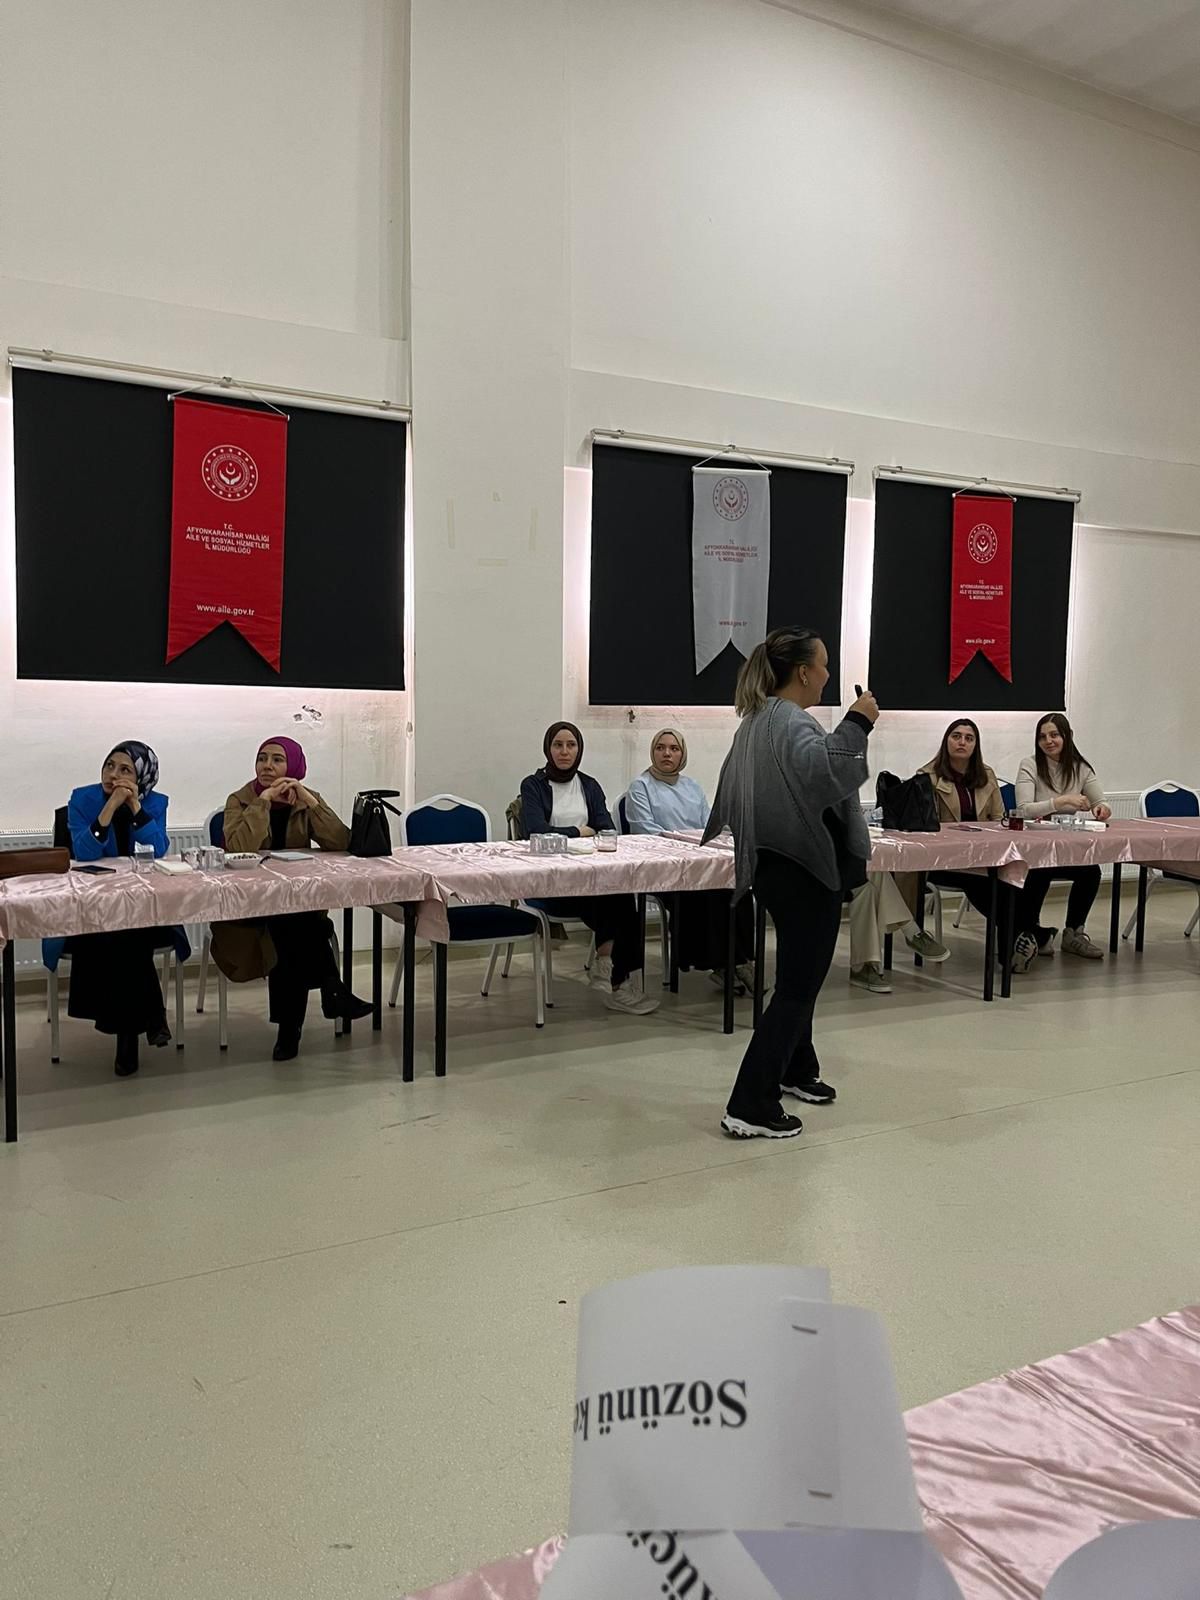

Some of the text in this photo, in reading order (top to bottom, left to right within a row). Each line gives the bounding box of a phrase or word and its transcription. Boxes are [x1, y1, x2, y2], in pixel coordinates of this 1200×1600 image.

[211, 536, 235, 546] SOSYAL
[236, 539, 270, 550] HİZMETLER
[196, 604, 255, 616] www.aile.gov.tr
[598, 1378, 747, 1435] Sözünü
